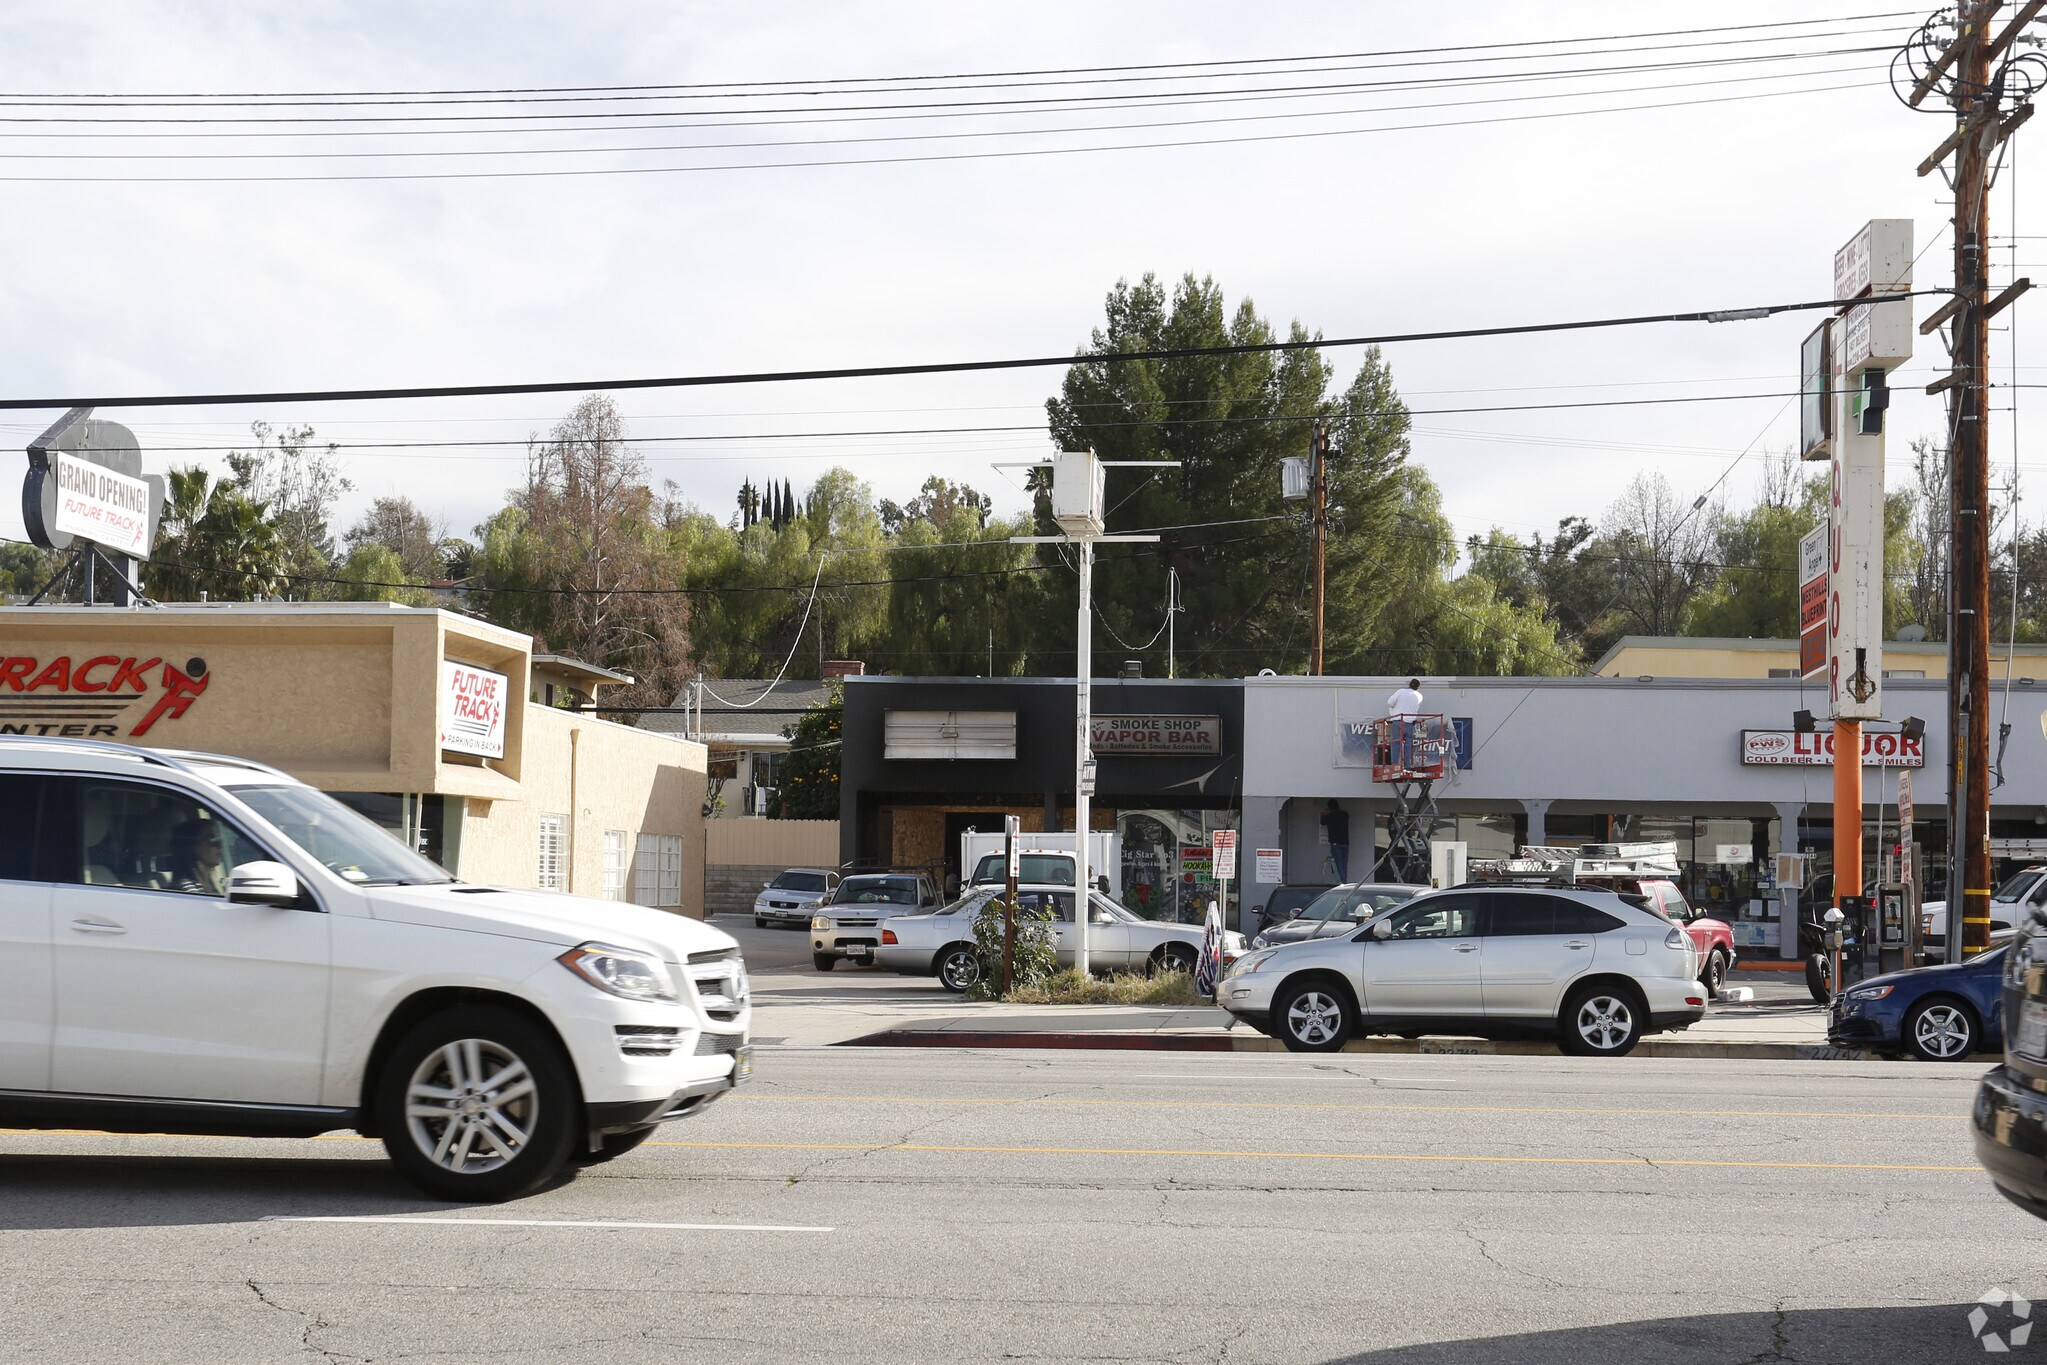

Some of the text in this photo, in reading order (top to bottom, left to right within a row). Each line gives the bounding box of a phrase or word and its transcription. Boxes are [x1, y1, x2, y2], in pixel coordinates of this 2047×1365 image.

[1835, 254, 1845, 281] BEER
[59, 460, 147, 516] GRAND OPENING!
[64, 498, 136, 531] FUTURE TRACK
[1805, 541, 1816, 556] Green
[1801, 599, 1827, 626] BLUEPRINT
[0, 656, 162, 692] RACK
[452, 669, 497, 700] FUTURE
[454, 694, 493, 721] TRACK
[1111, 720, 1202, 731] SMOKE SHOP
[447, 734, 497, 751] PARKING IN BACK
[1091, 730, 1210, 743] VAPOR BAR
[1749, 739, 1786, 748] PWS
[1172, 743, 1213, 751] Accessories
[1746, 756, 1922, 766] COLD BEER SMILES
[1135, 849, 1154, 859] Star
